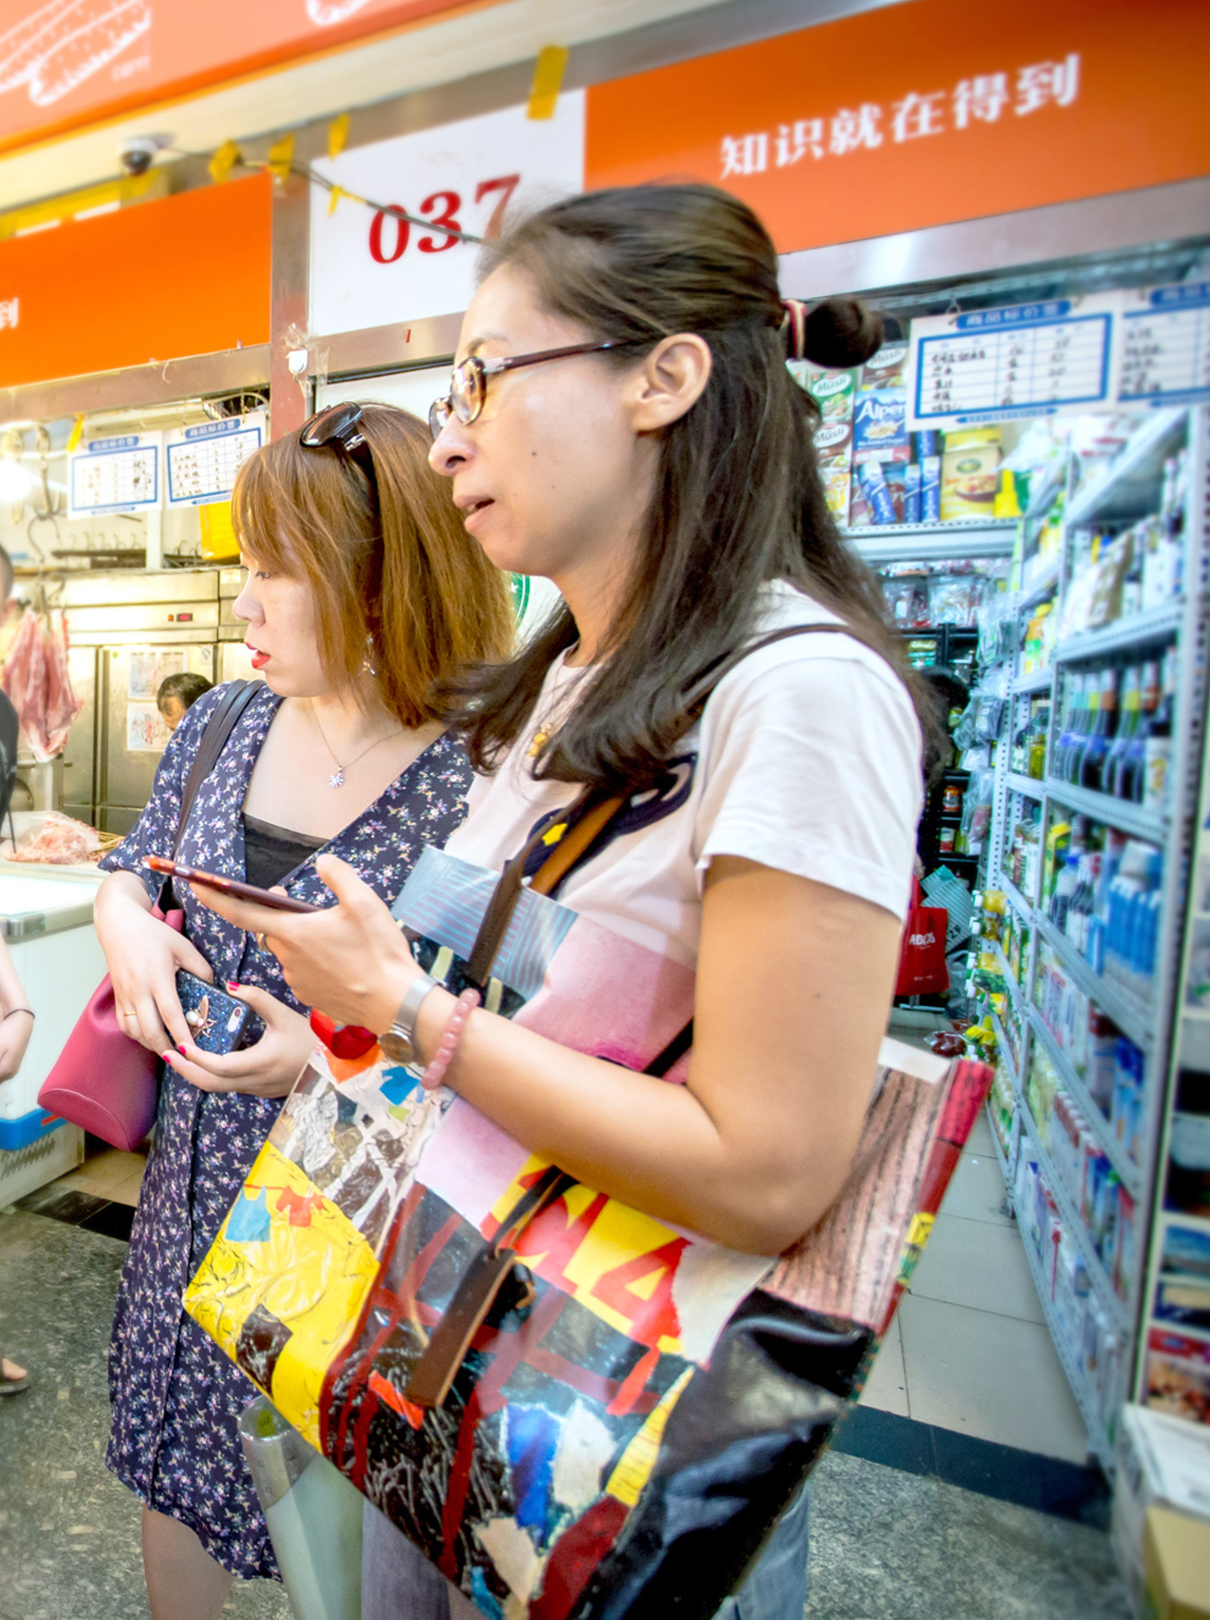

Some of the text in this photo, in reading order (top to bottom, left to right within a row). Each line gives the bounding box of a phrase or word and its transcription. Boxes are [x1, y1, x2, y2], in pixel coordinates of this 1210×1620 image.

[720, 52, 1080, 181] 知识就在得到
[369, 172, 522, 264] 037
